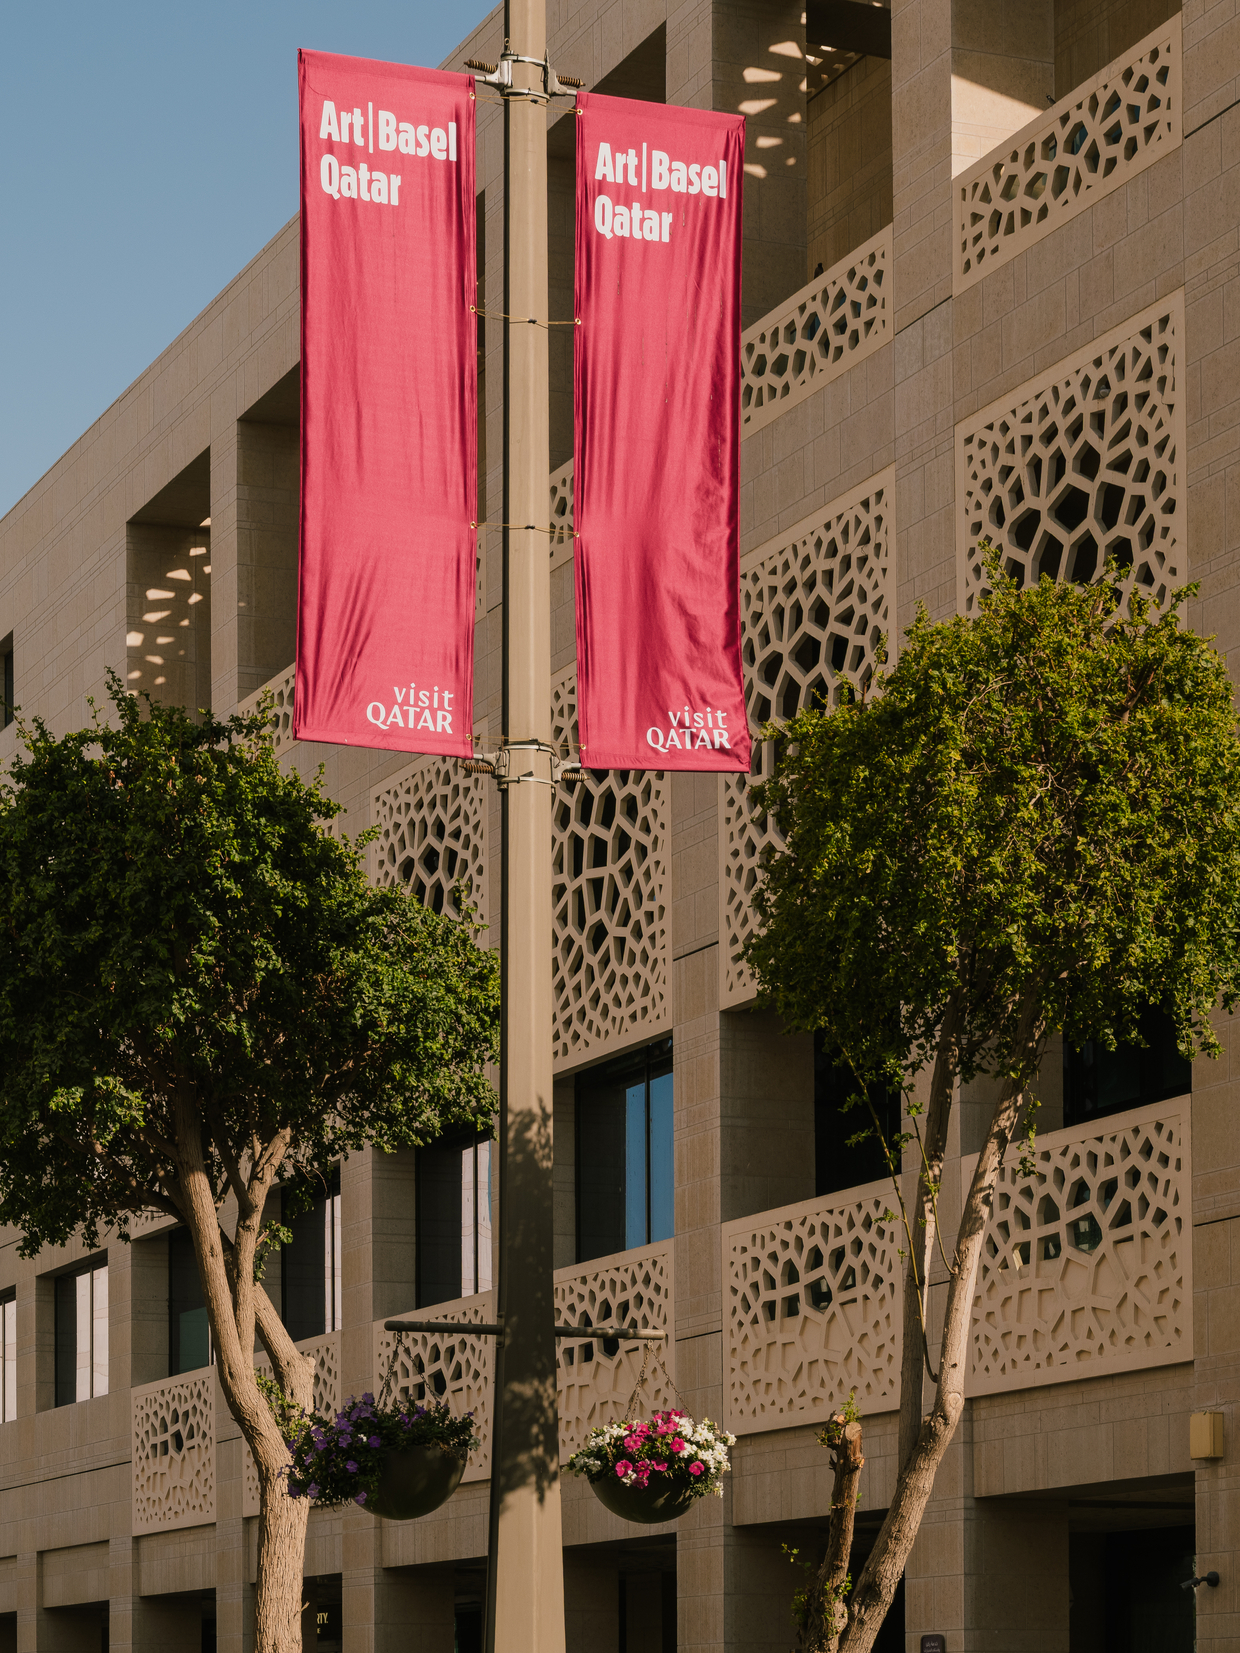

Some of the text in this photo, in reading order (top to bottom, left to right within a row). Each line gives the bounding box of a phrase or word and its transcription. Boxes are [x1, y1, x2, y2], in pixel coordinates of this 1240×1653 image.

[320, 154, 401, 205] Qatar
[594, 194, 673, 243] Qatar
[393, 682, 454, 711] visit
[366, 702, 453, 734] QATAR
[668, 706, 728, 727] visit
[647, 726, 732, 753] QATAR
